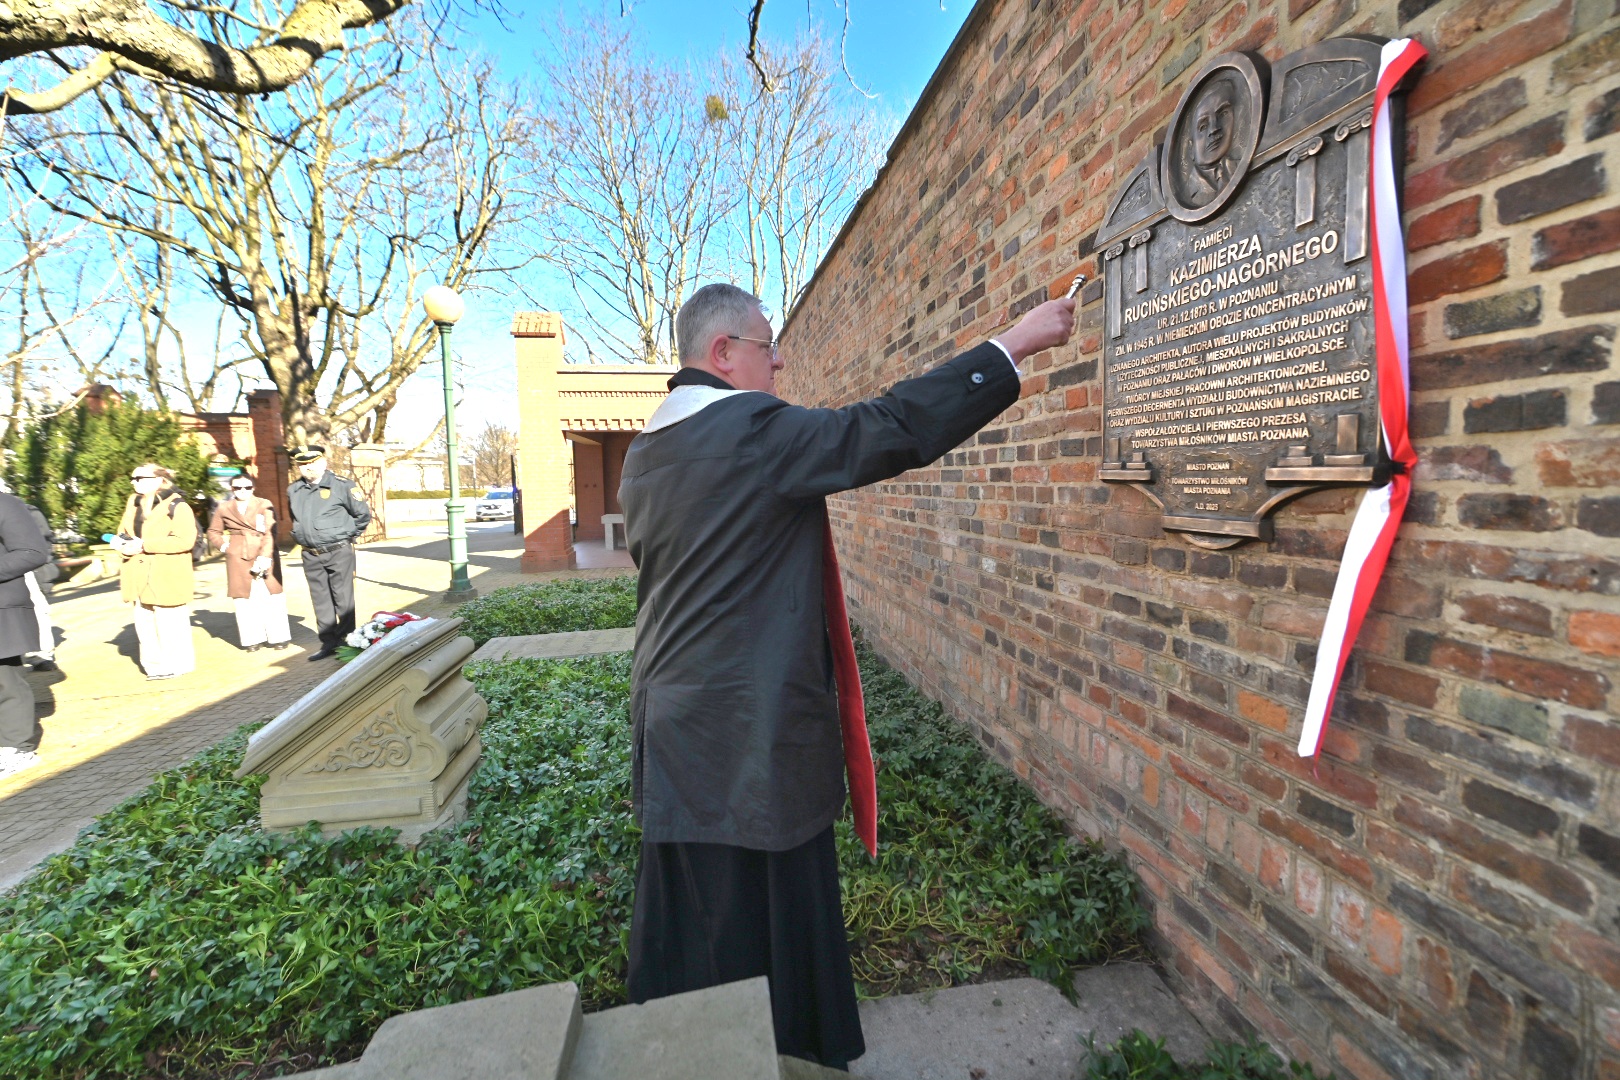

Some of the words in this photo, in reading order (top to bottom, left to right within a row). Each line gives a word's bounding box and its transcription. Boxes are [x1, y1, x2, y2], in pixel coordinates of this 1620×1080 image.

[1170, 234, 1262, 286] KAZIMIERZA
[1194, 225, 1232, 252] PAMIĘCI
[1125, 230, 1338, 324] RUCIŃSKIEGO-NAGÓRNEGO
[1116, 346, 1126, 356] ZM.
[1126, 344, 1133, 353] W
[1134, 338, 1148, 351] 1945
[1148, 336, 1156, 347] R.
[1157, 334, 1164, 344] W
[1164, 320, 1208, 343] NIEMIECKIM
[1210, 310, 1242, 330] OBOZIE
[1244, 274, 1356, 320] KONCENTRACYJNYM
[1158, 318, 1170, 329] UR.
[1170, 304, 1208, 326] 21.12.1873
[1209, 302, 1218, 314] R.
[1219, 296, 1228, 310] W
[1230, 280, 1279, 307] POZNANIU
[1110, 358, 1140, 373] UZNANEGO
[1141, 348, 1181, 364] ARCHITEKTA,
[1182, 340, 1213, 356] AUTORA
[1214, 332, 1239, 347] WIELU
[1240, 316, 1299, 341] PROJEKTÓW
[1301, 298, 1367, 326] BUDYNKÓW
[1117, 362, 1160, 382] UŻYTECZNOŚCI
[1161, 355, 1205, 371] PUBLICZNEJ,
[1206, 338, 1270, 363] MIESZKALNYCH
[1272, 338, 1275, 347] I
[1278, 320, 1349, 346] SAKRALNYCH
[1117, 383, 1123, 392] W
[1123, 378, 1152, 392] POZNANIU
[1154, 374, 1171, 386] ORAZ
[1172, 366, 1206, 381] PAŁACÓW
[1208, 366, 1210, 375] I
[1212, 355, 1252, 374] DWORÓW
[1253, 355, 1262, 366] W
[1263, 337, 1348, 366] WIELKOPOLSCE.
[1126, 392, 1150, 404] TWÓRCY
[1151, 387, 1184, 400] MIEJSKIEJ
[1185, 378, 1225, 394] PRACOWNI
[1226, 360, 1328, 387] ARCHITEKTONICZNEJ,
[1108, 405, 1142, 417] PIERWSZEGO
[1143, 400, 1185, 412] DECERNENTA
[1186, 391, 1224, 406] WYDZIAŁU
[1225, 381, 1294, 400] BUDOWNICTWA
[1296, 369, 1370, 391] NAZIEMNEGO
[1110, 419, 1124, 428] ORAZ
[1125, 416, 1154, 426] WYDZIAŁU
[1156, 411, 1184, 422] KULTURY
[1185, 410, 1188, 418] I
[1190, 407, 1216, 418] SZTUKI
[1217, 404, 1225, 414] W
[1226, 396, 1284, 413] POZNAŃSKIM
[1286, 387, 1363, 406] MAGISTRACIE.
[1131, 438, 1178, 449] TOWARZYSTWA
[1179, 432, 1226, 446] MIŁOŚNIKÓW
[1228, 431, 1258, 443] MIASTA
[1260, 427, 1311, 440] POZNANIA.
[1135, 424, 1201, 437] WSPÓŁZAŁOŻYCIELA
[1202, 423, 1205, 431] I
[1206, 417, 1260, 431] PIERWSZEGO
[1262, 412, 1306, 426] PREZESA
[1207, 462, 1230, 470] POZNAŃ
[1211, 476, 1248, 485] MIŁOŚNIKÓW
